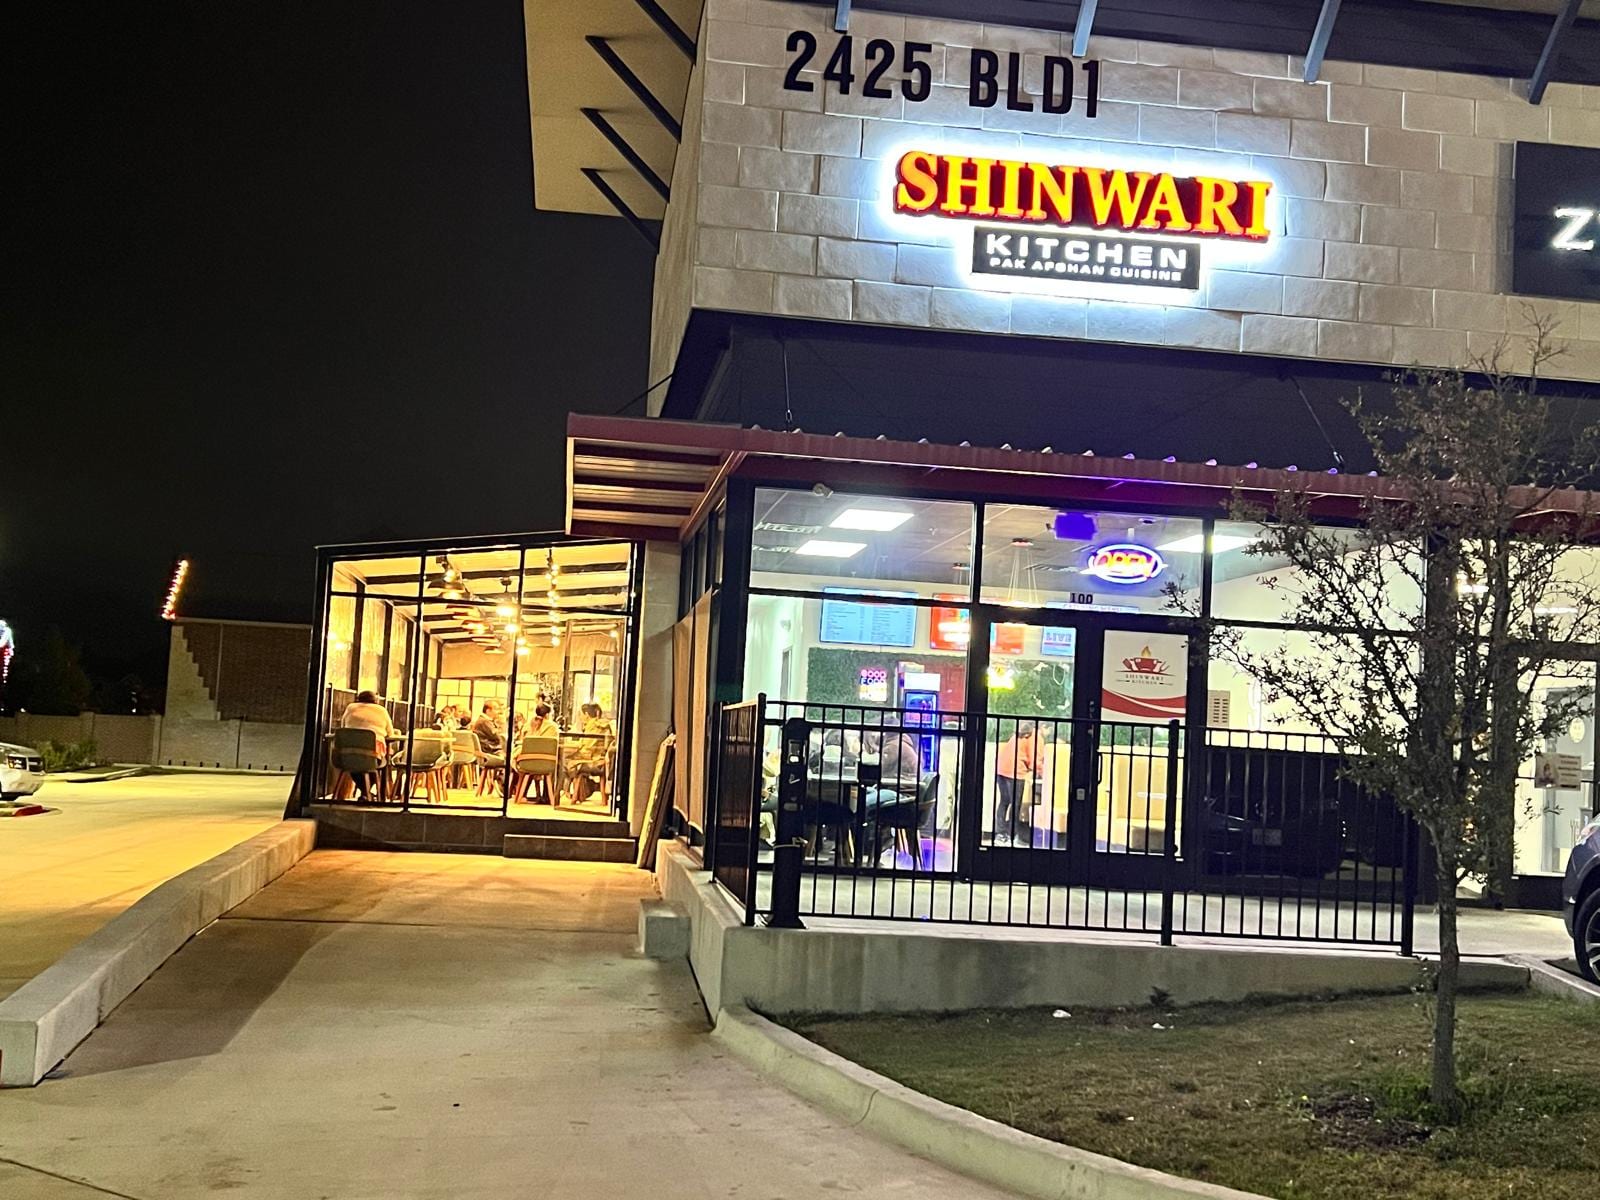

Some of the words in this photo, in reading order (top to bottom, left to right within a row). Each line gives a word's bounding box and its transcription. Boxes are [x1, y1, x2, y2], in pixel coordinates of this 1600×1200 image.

[783, 30, 933, 102] 2425
[969, 49, 1100, 118] BLD1
[894, 150, 1273, 243] SHINWARI
[1552, 207, 1600, 250] Z
[986, 234, 1187, 269] KITCHEN
[989, 257, 1026, 269] PAK
[1031, 260, 1104, 276] AFGHAN
[1110, 267, 1182, 281] CUISINE
[1094, 551, 1152, 577] OPEN
[1070, 592, 1093, 605] 100
